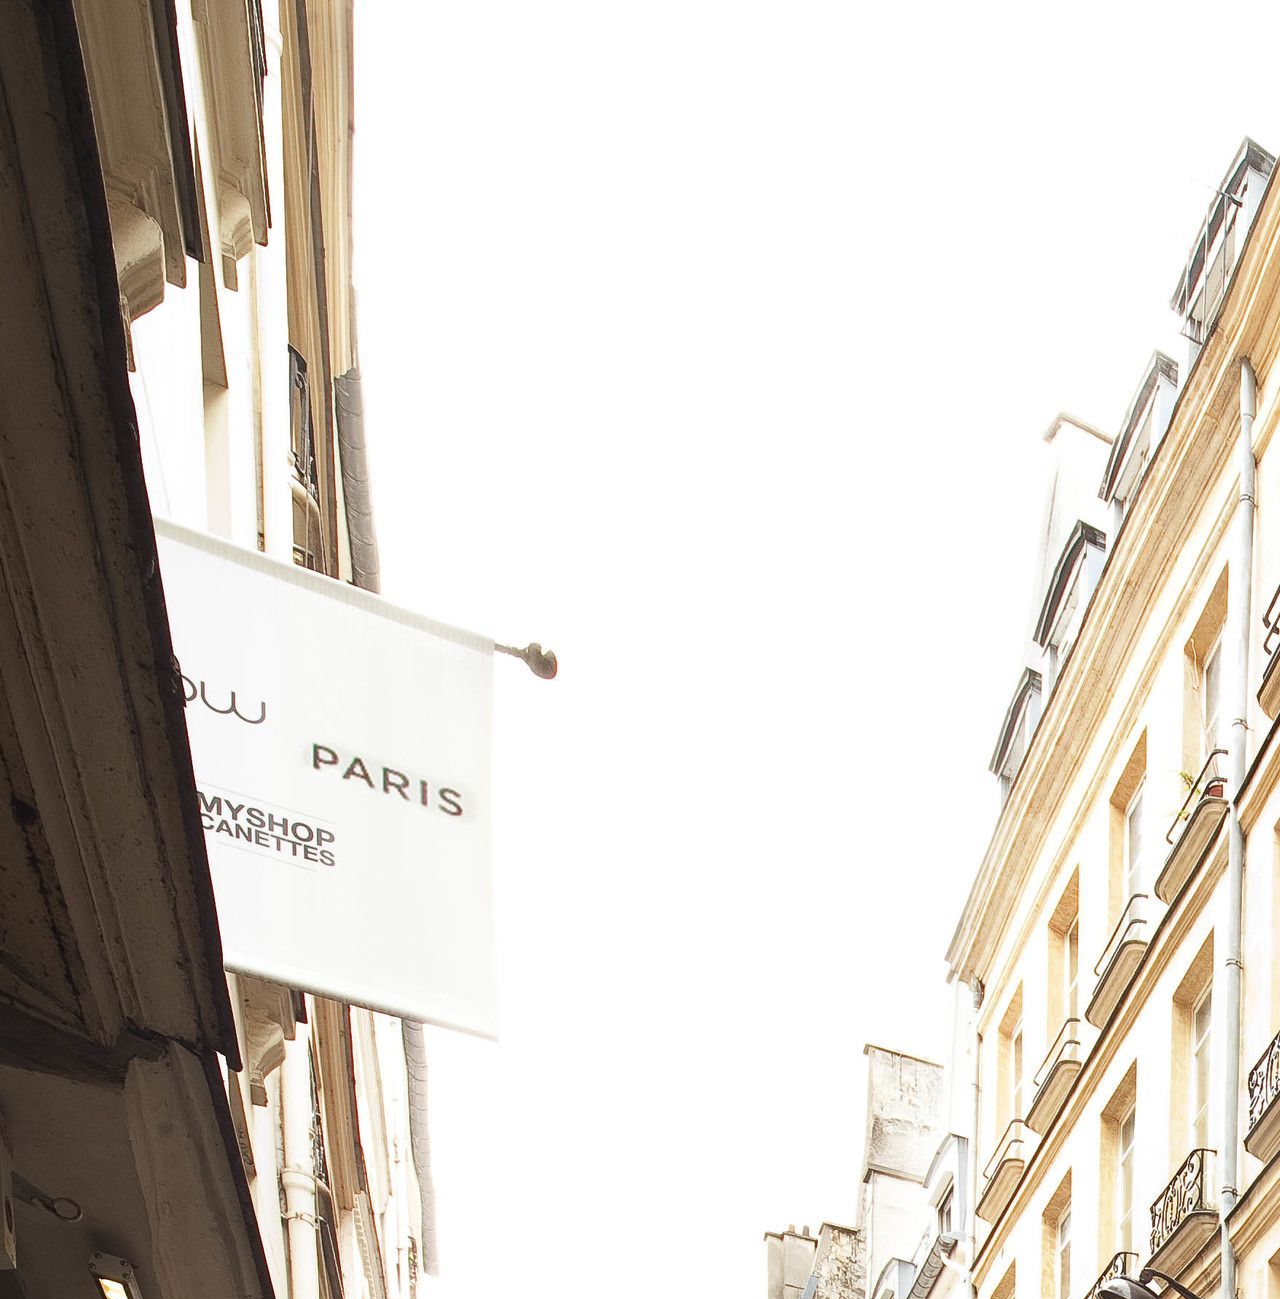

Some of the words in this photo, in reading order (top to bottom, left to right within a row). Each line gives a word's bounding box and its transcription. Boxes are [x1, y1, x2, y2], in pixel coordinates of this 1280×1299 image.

[312, 742, 463, 817] PARIS
[197, 790, 335, 847] MYSHOP
[200, 811, 336, 867] CANETTES
